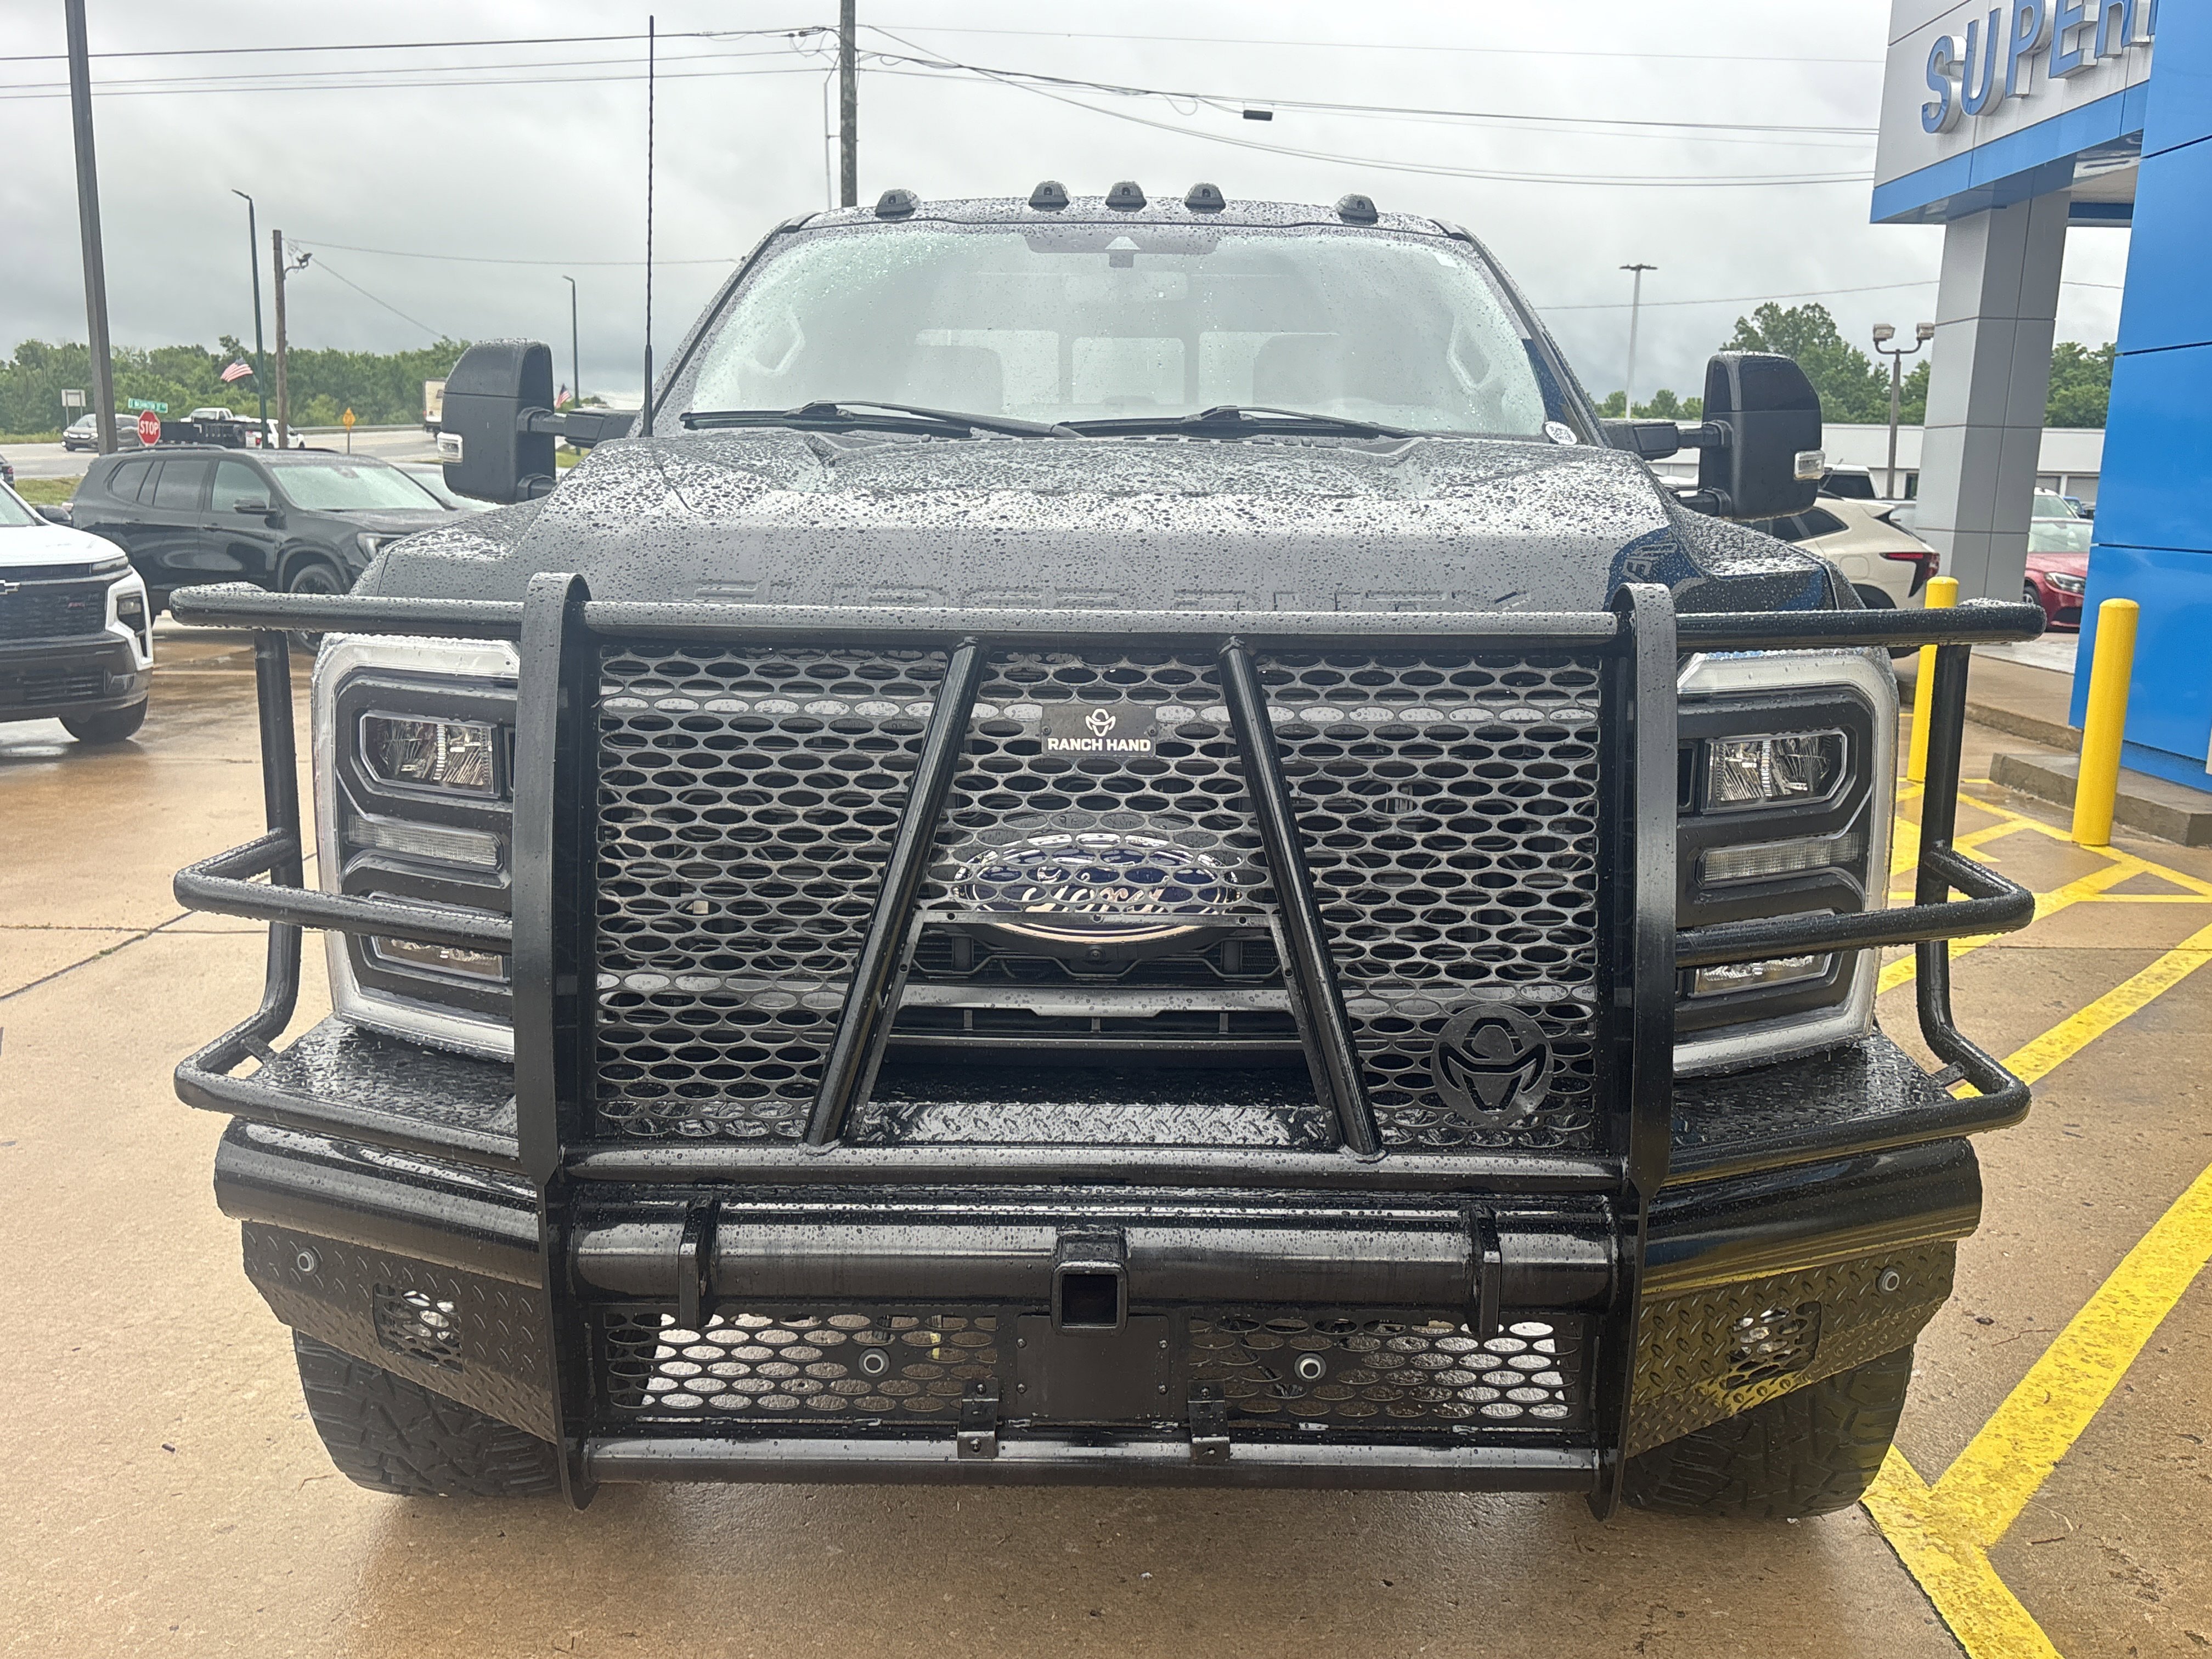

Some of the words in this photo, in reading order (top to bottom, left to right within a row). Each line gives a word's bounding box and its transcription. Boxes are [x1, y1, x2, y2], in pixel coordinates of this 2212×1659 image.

[140, 420, 159, 435] STOP
[1048, 738, 1103, 751] RANCH
[1106, 739, 1151, 751] HAND
